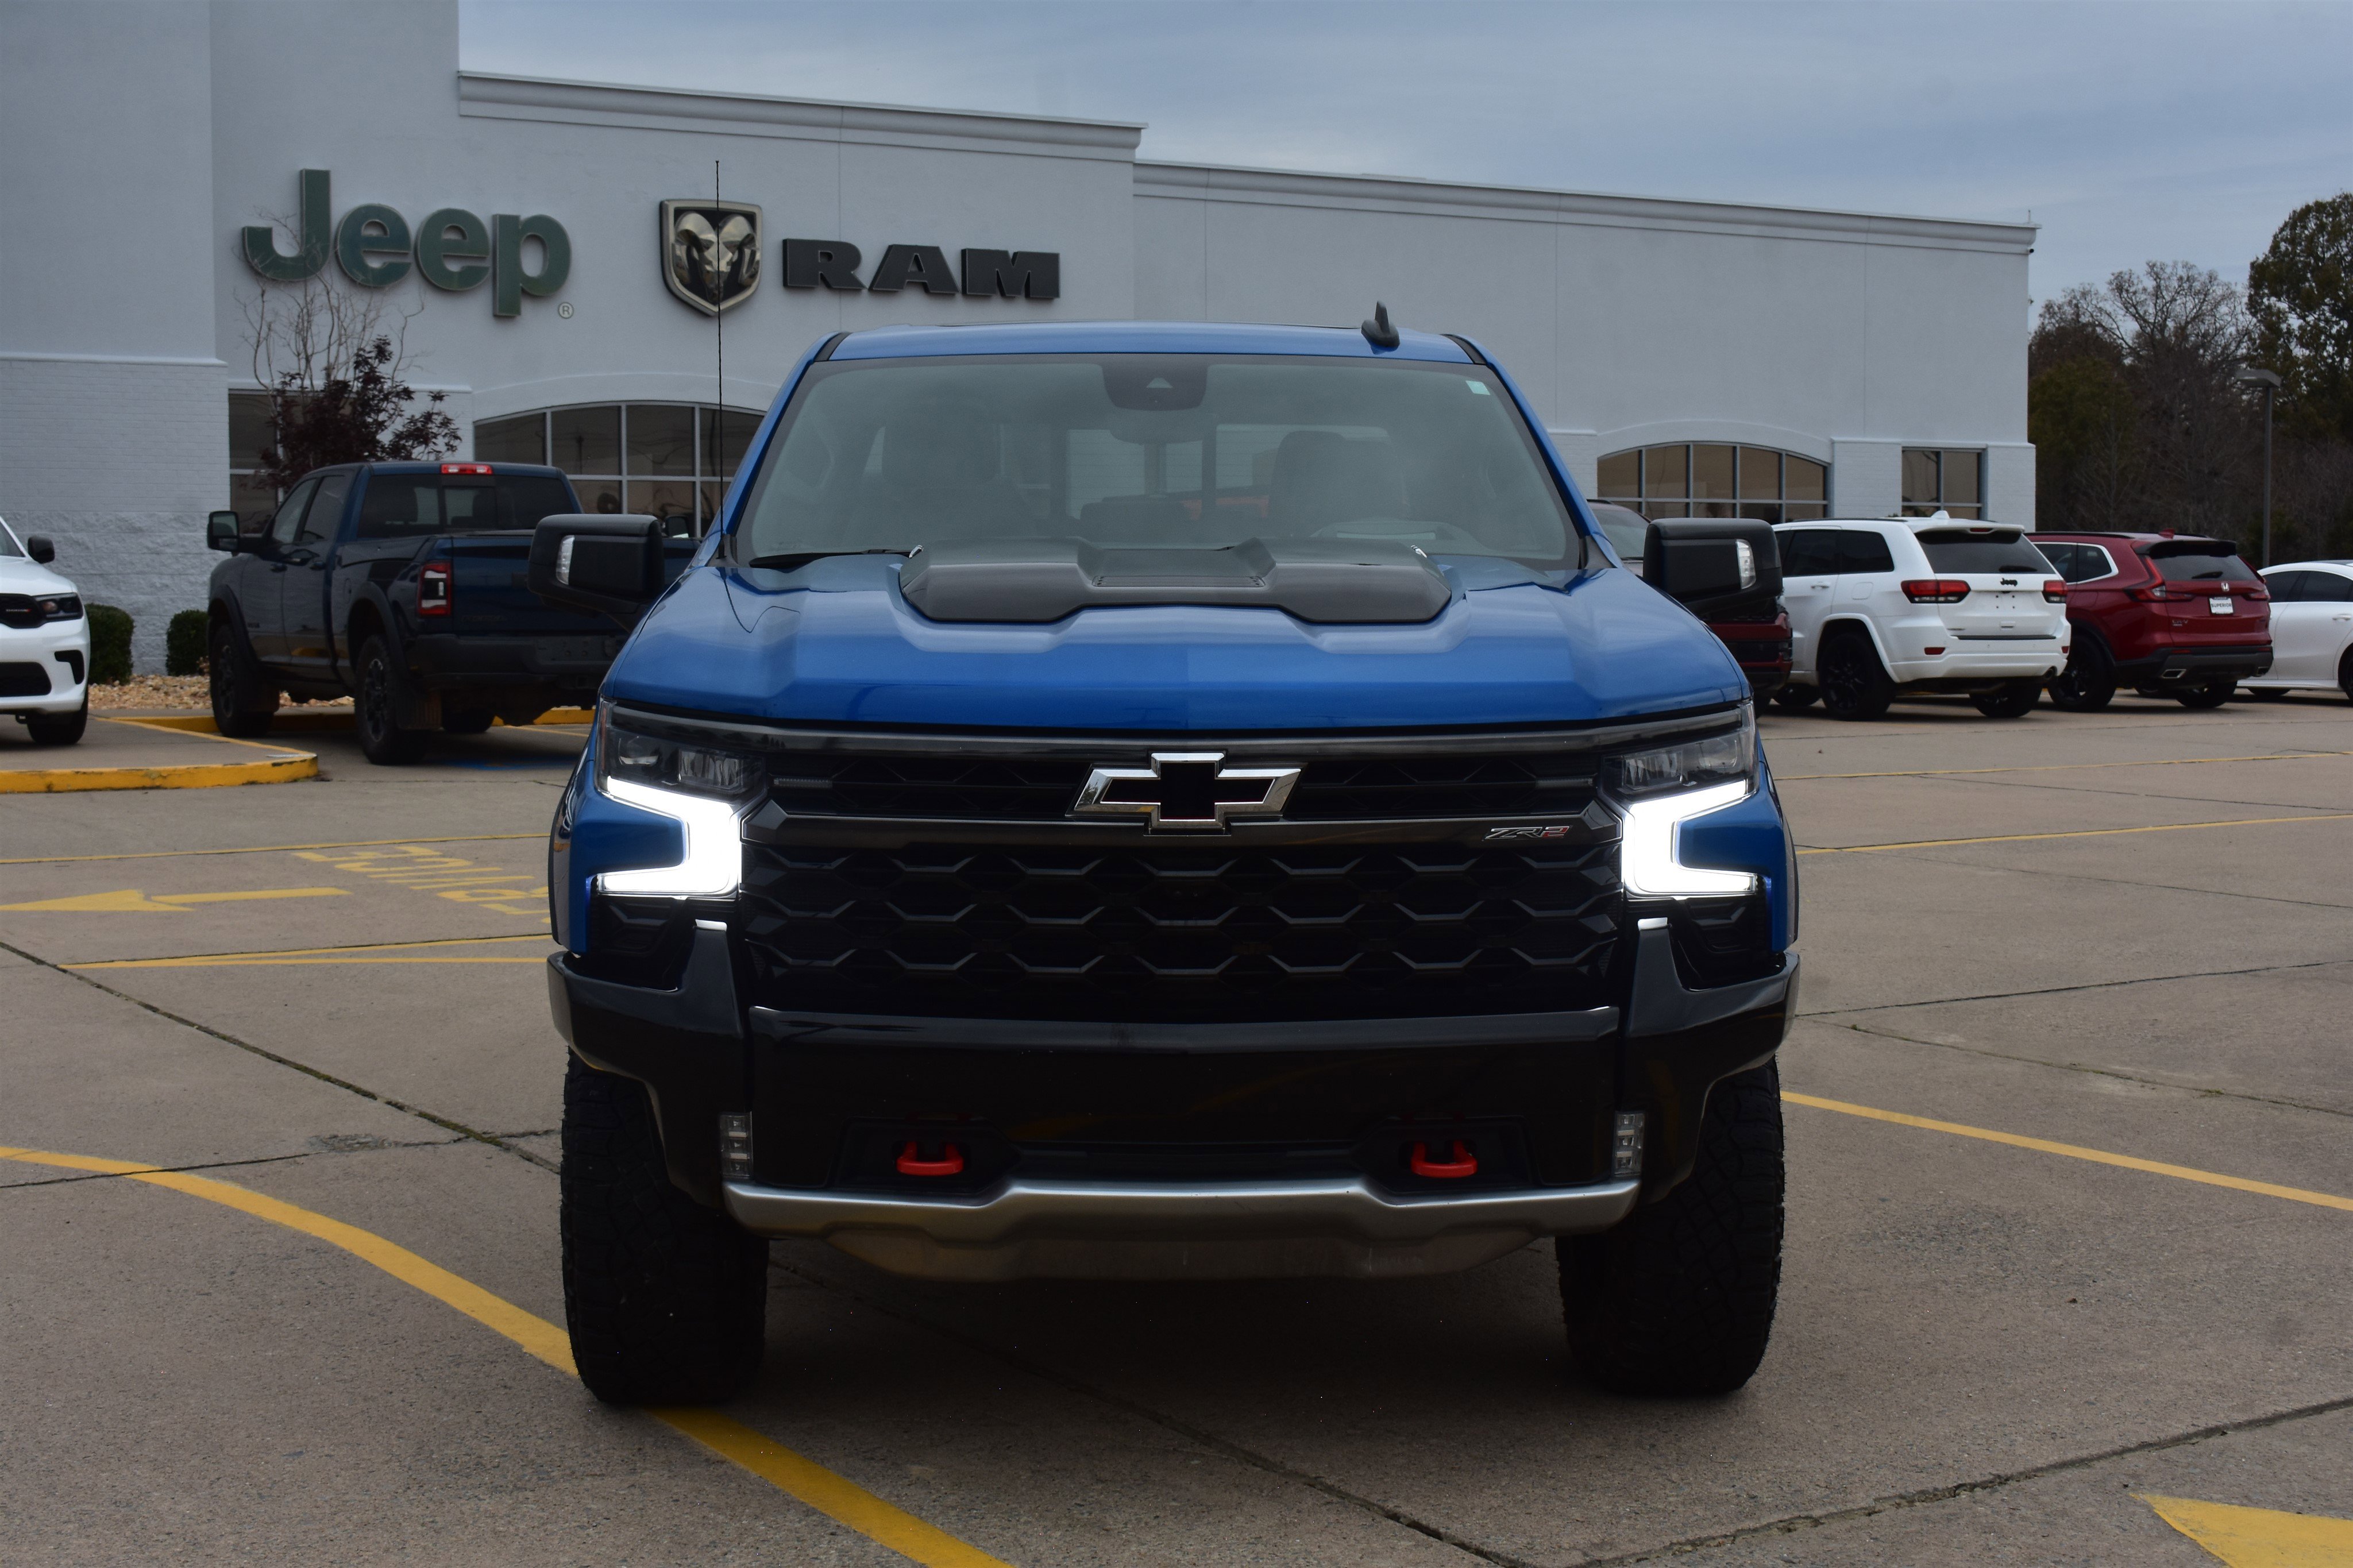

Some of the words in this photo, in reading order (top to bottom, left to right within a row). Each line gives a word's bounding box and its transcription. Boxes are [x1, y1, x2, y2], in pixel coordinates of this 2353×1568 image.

[242, 168, 572, 317] Jeep
[782, 238, 1060, 299] RAM
[1483, 825, 1570, 840] ZR2
